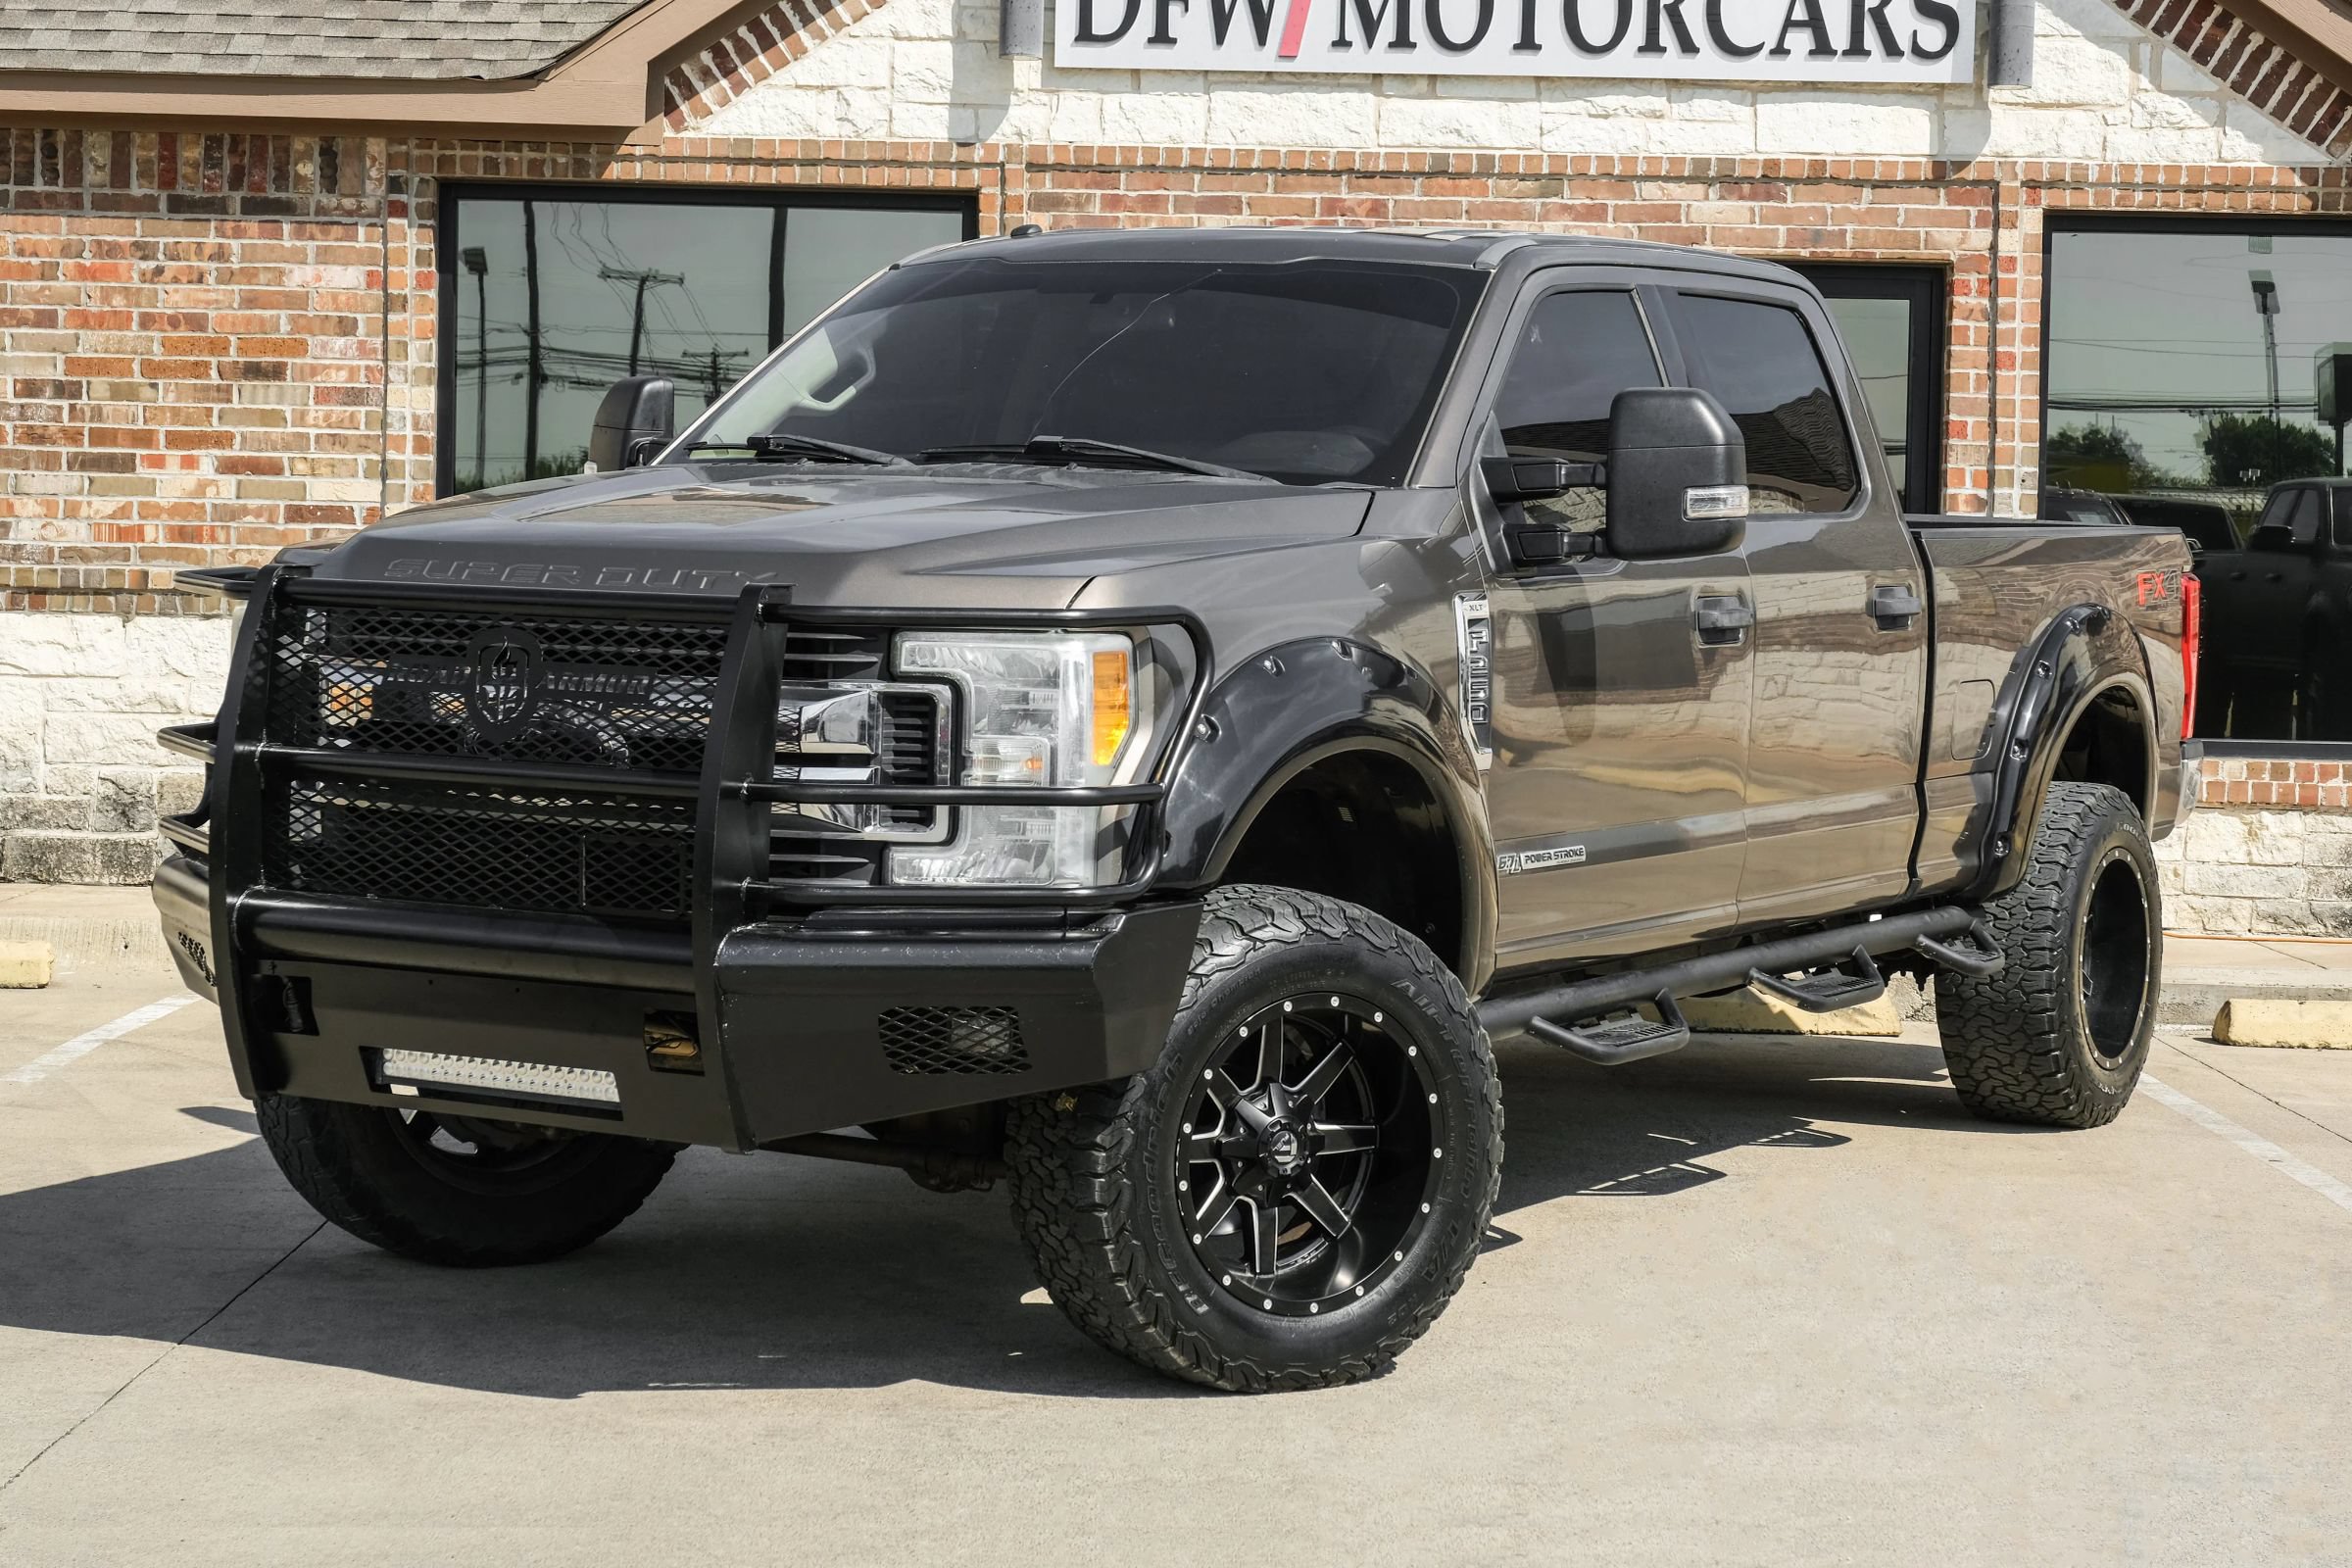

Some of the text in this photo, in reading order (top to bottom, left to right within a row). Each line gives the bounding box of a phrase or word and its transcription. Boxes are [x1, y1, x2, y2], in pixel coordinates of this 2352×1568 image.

[384, 559, 777, 589] SUPER DUTY
[2136, 569, 2180, 607] FX4
[1524, 852, 1553, 864] POWER
[1553, 847, 1585, 860] STROKE
